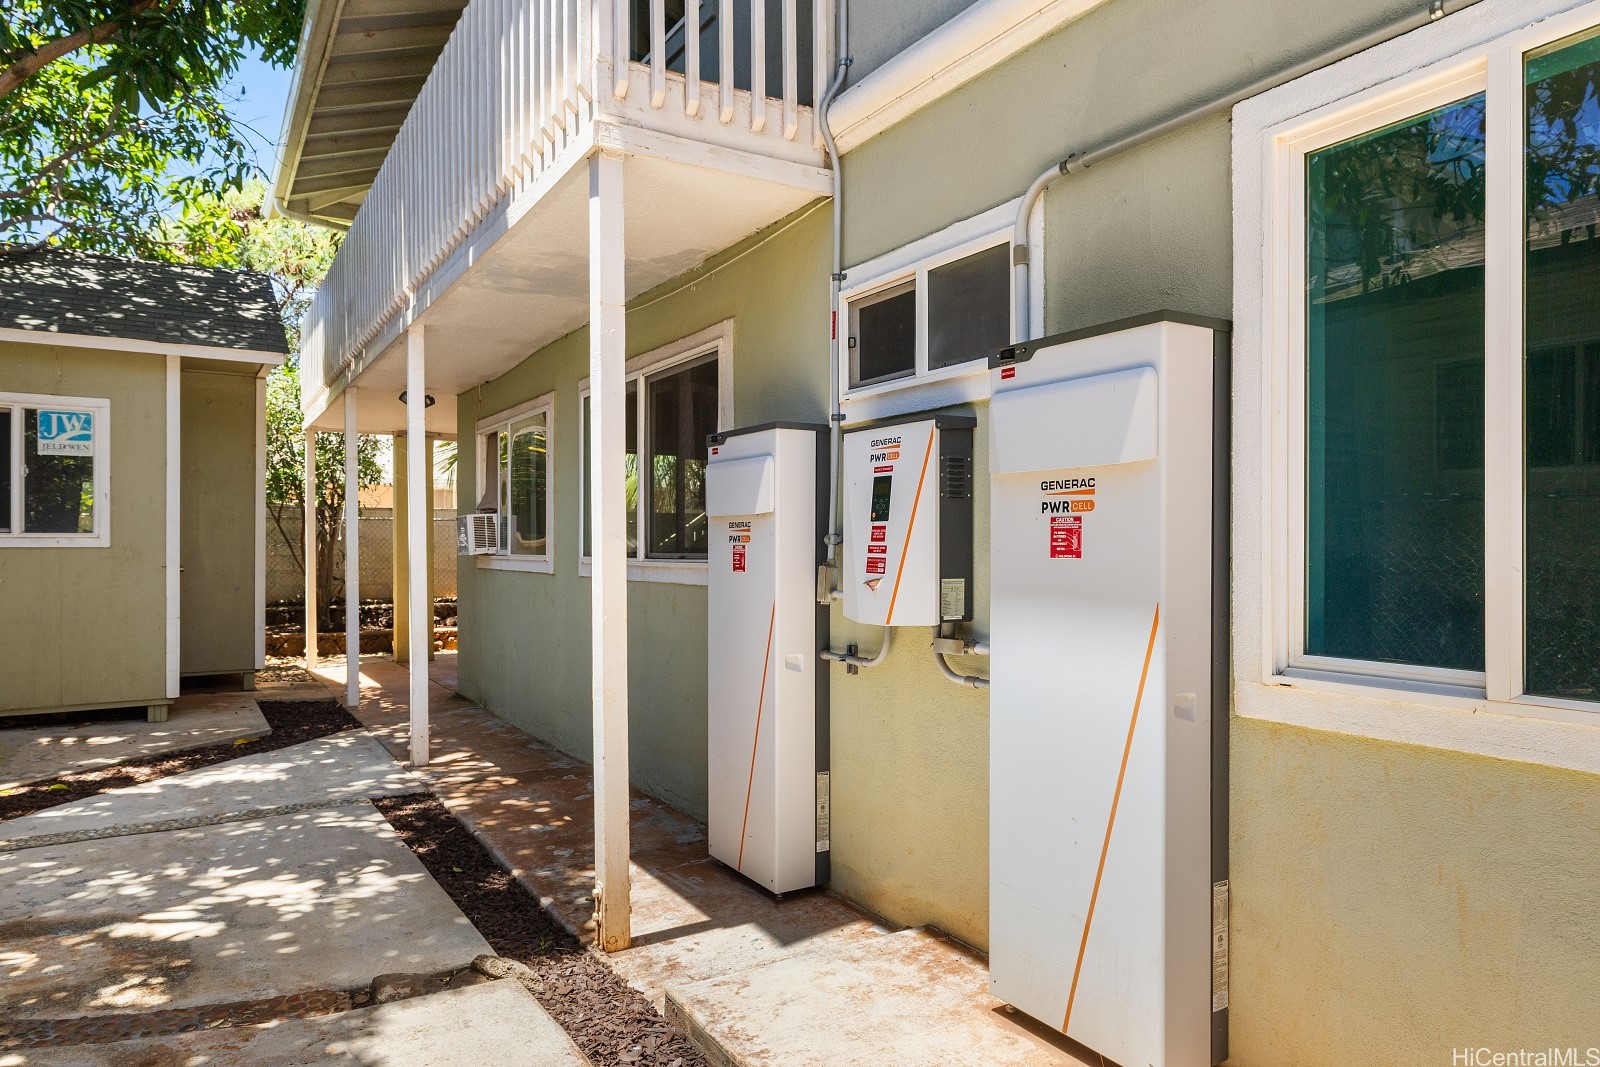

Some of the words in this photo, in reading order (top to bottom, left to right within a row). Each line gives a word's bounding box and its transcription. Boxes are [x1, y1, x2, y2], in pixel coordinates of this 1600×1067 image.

[44, 413, 87, 438] JW
[870, 436, 902, 448] GENERAC
[870, 452, 887, 463] PWR
[1040, 477, 1096, 491] GENERAC
[1041, 500, 1070, 514] PWR
[1072, 502, 1092, 511] CELL
[728, 521, 752, 529] GENERAC
